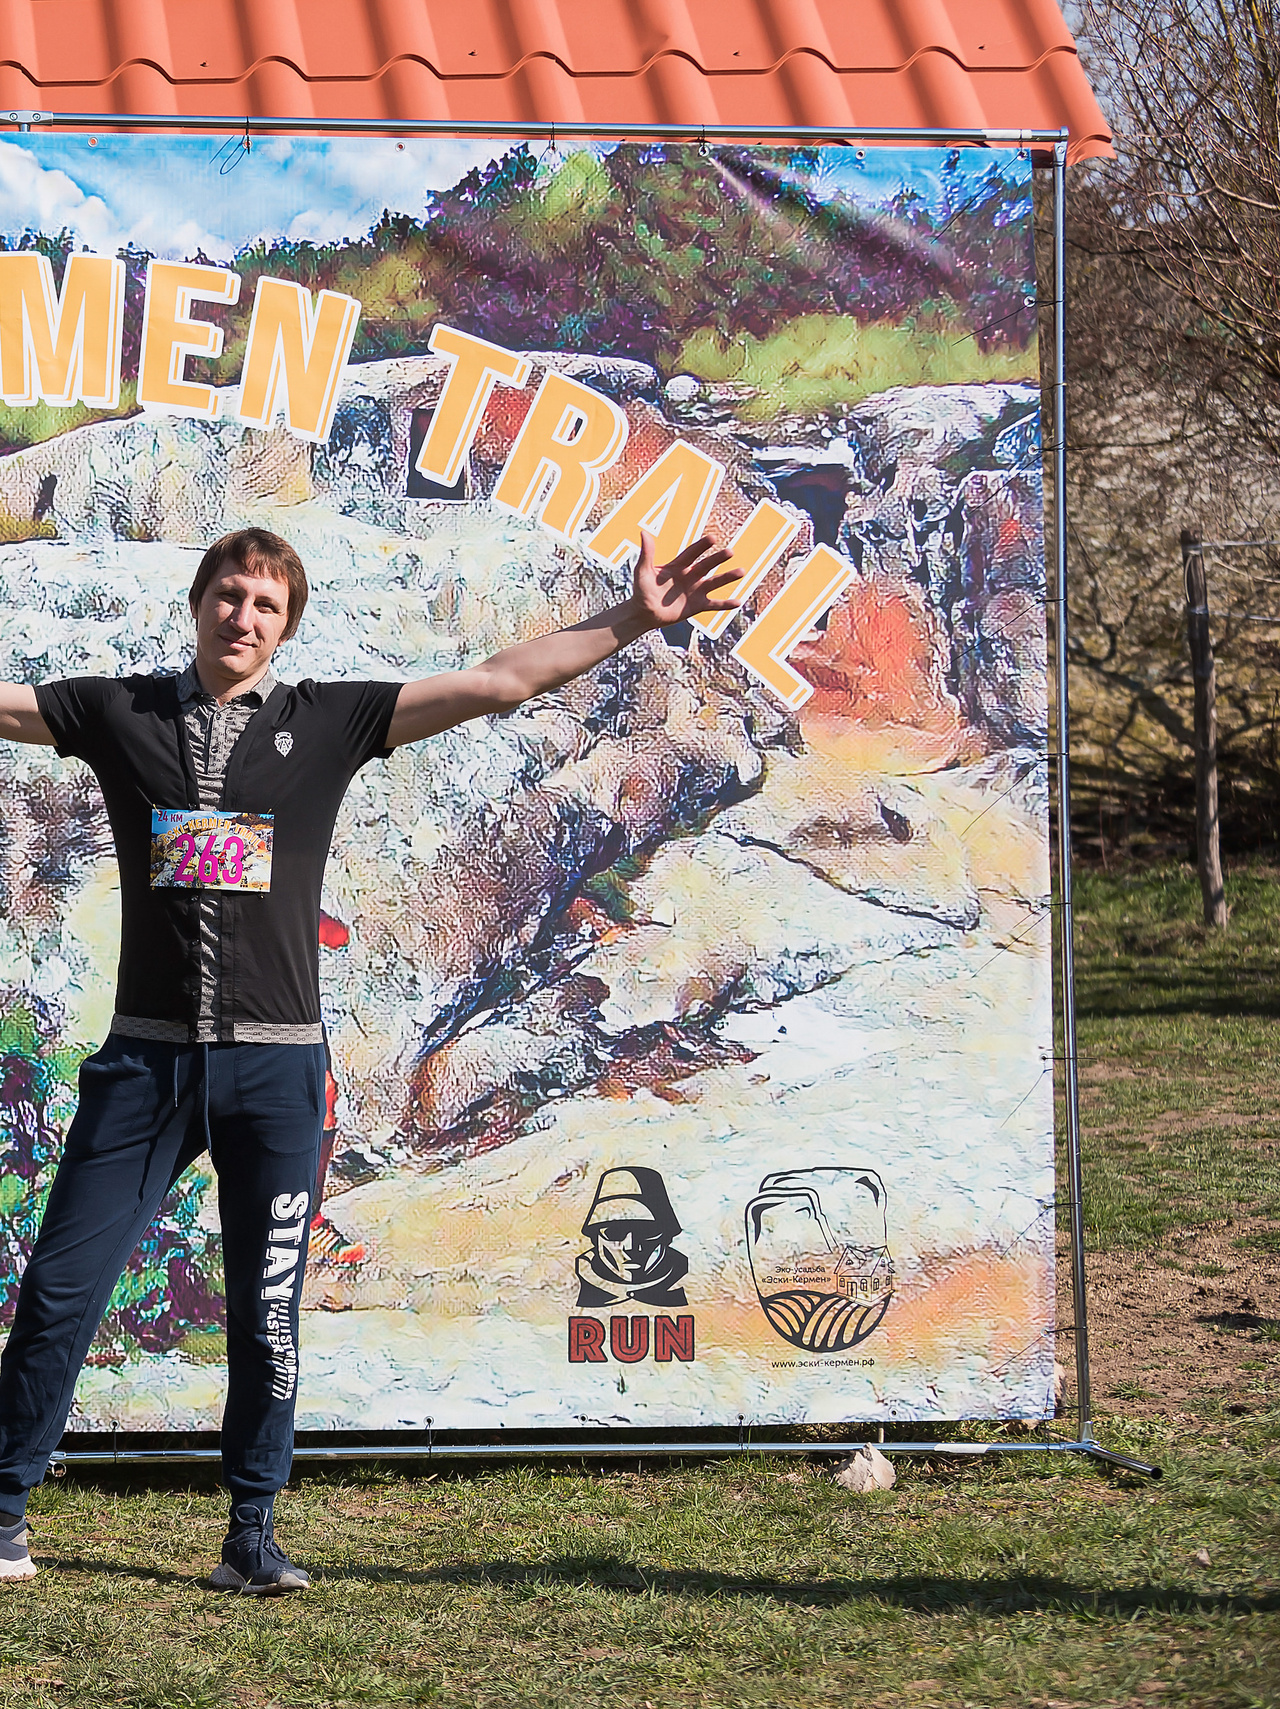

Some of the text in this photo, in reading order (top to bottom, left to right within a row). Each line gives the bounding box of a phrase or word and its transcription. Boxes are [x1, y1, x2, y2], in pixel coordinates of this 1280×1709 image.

[414, 322, 858, 712] TRAIL
[158, 811, 169, 822] 24
[162, 817, 263, 848] ESKI-KERMEN TRAIL
[174, 833, 244, 884] 263
[261, 1190, 309, 1301] STAY
[761, 1275, 832, 1284] «Эски-Кермен»
[774, 1265, 826, 1275] Эко-усадьба
[266, 1303, 284, 1354] FASTER
[568, 1315, 695, 1363] RUN
[771, 1358, 875, 1368] www.эски-кермен.рф
